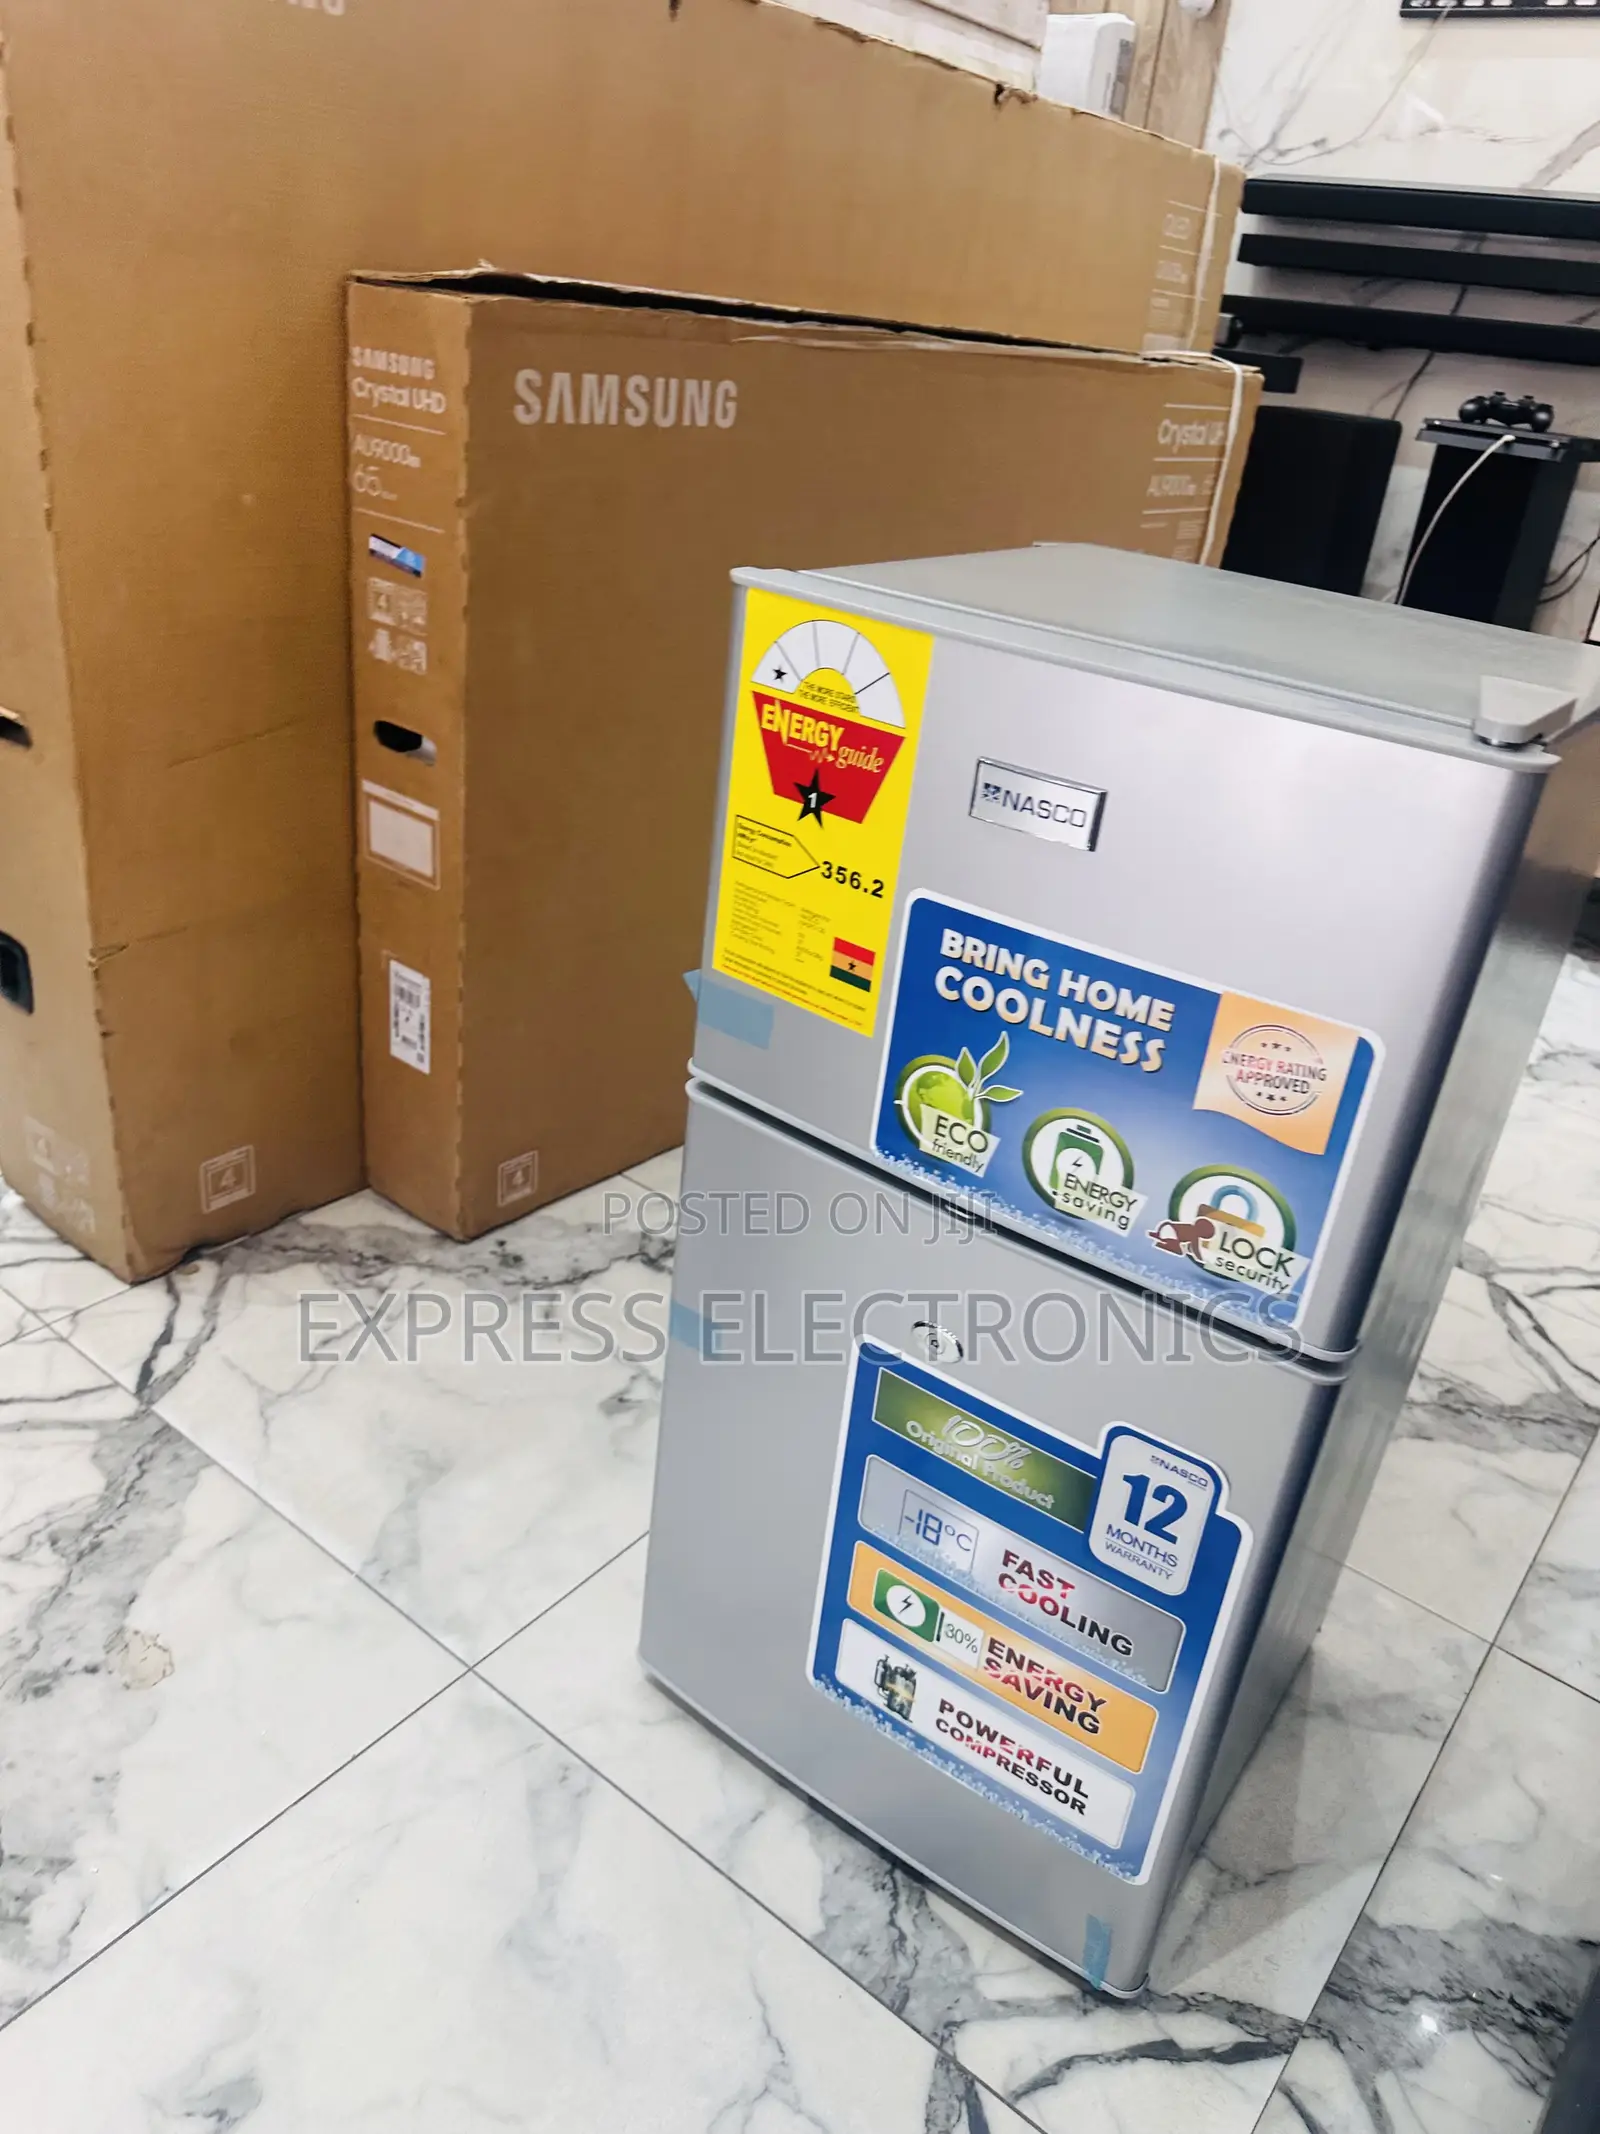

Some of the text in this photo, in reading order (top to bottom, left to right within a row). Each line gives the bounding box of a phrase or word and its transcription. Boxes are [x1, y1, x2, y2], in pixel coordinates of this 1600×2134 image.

[352, 346, 435, 380] SAMSUNG
[352, 376, 447, 414] Crystal UHD
[513, 368, 738, 429] SAMSUNG
[1157, 418, 1207, 454] Crystal
[760, 699, 885, 774] ENERGY guide
[807, 792, 819, 809] 1
[1001, 789, 1088, 828] NASCO
[821, 860, 885, 899] 356.2
[940, 928, 1050, 990] BRING
[1057, 968, 1176, 1032] HOME
[934, 965, 1167, 1073] COOLNESS
[1222, 1051, 1327, 1082] ENERGY RATING
[1235, 1069, 1310, 1095] APPROVED
[931, 1137, 985, 1173] friendly
[934, 1114, 990, 1154] ECO
[1061, 1190, 1131, 1231] saving
[1064, 1172, 1138, 1214] ENERGY
[1214, 1256, 1291, 1295] security
[1219, 1231, 1296, 1278] LOCK
[941, 1414, 1032, 1470] 100%
[906, 1420, 1056, 1510] Original Product
[1157, 1458, 1209, 1488] NASCO
[1122, 1473, 1188, 1545] 12
[1104, 1541, 1174, 1580] WARRANTY
[1105, 1523, 1179, 1568] MONTHS
[1001, 1549, 1076, 1600] FAST
[998, 1572, 1134, 1657] COOLING
[944, 1622, 979, 1654] 30%
[987, 1636, 1108, 1713] ENERGY
[983, 1657, 1102, 1735] SAVING
[935, 1717, 1087, 1816] COMPRESSOR
[938, 1698, 1090, 1800] POWERFUL
